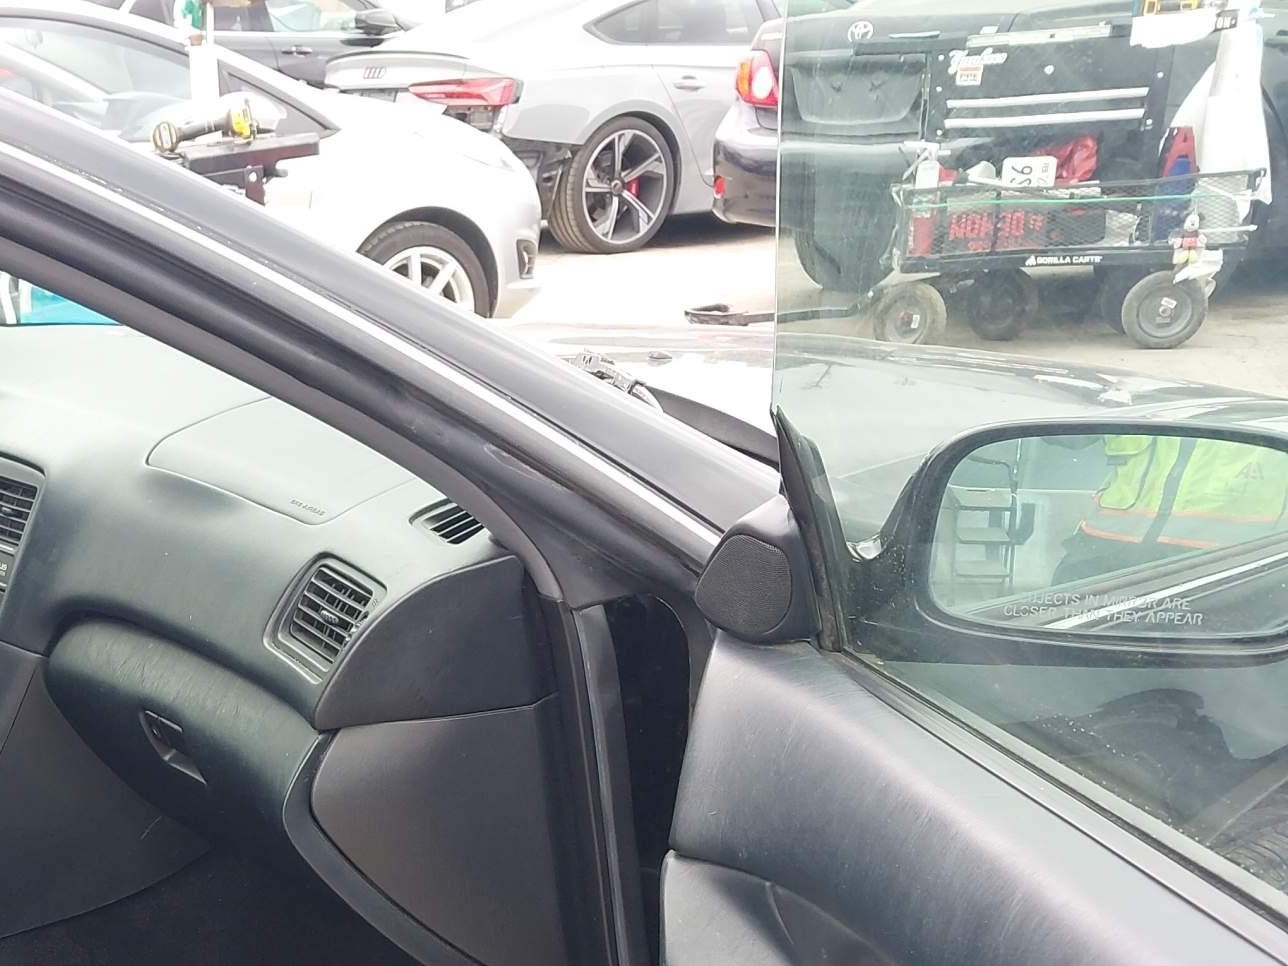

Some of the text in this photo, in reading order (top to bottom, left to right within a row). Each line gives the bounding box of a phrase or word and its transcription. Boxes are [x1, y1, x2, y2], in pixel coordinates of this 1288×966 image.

[1162, 597, 1191, 610] ARE
[1106, 609, 1140, 622] THEY
[1145, 611, 1203, 625] APPEAR
